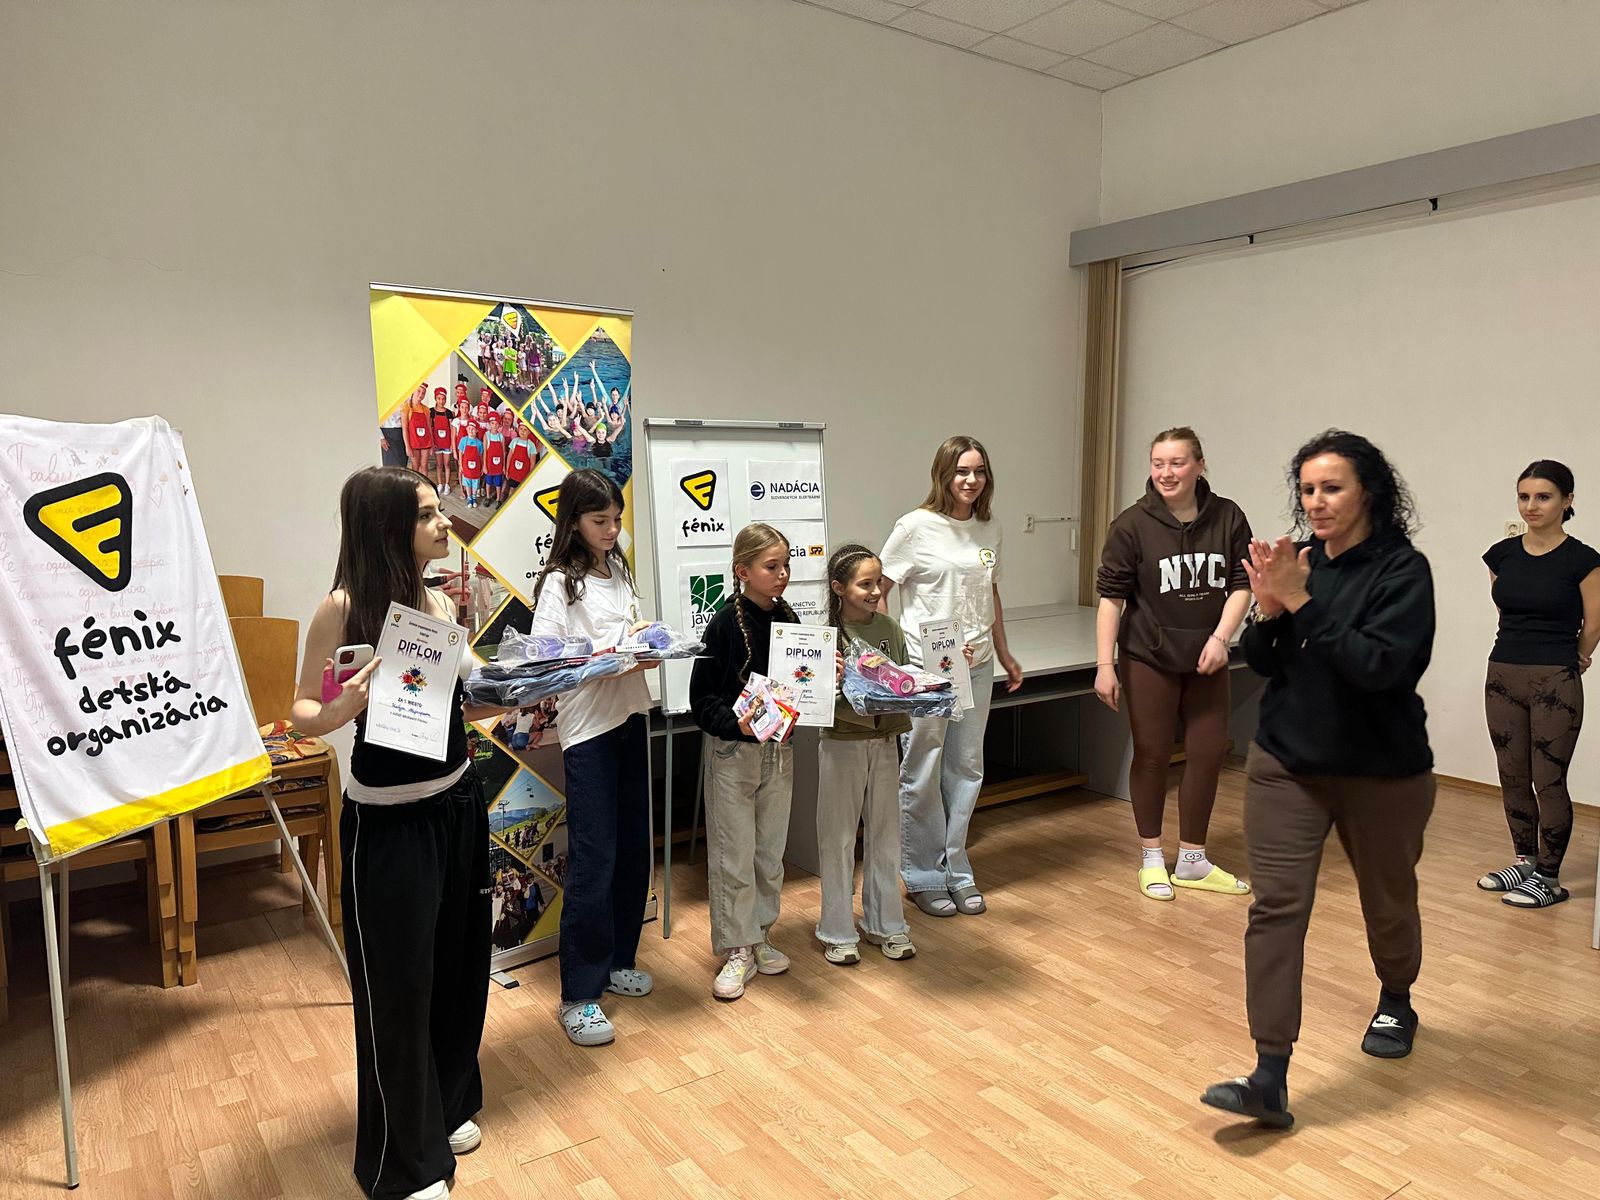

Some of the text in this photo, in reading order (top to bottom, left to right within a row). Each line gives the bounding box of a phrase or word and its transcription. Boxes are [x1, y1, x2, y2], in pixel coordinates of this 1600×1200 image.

[770, 480, 820, 493] NADÁCIA
[681, 517, 725, 538] fénix
[535, 533, 553, 555] fé
[789, 545, 823, 558] cia SPP
[1159, 553, 1226, 594] NYC
[53, 609, 182, 681] fénix
[397, 639, 442, 663] DIPLOM
[786, 647, 822, 658] DIPLOM
[932, 639, 955, 650] DIPLOM
[78, 670, 192, 714] detská
[47, 692, 228, 757] organizácia
[1376, 1013, 1399, 1025] NIKE
